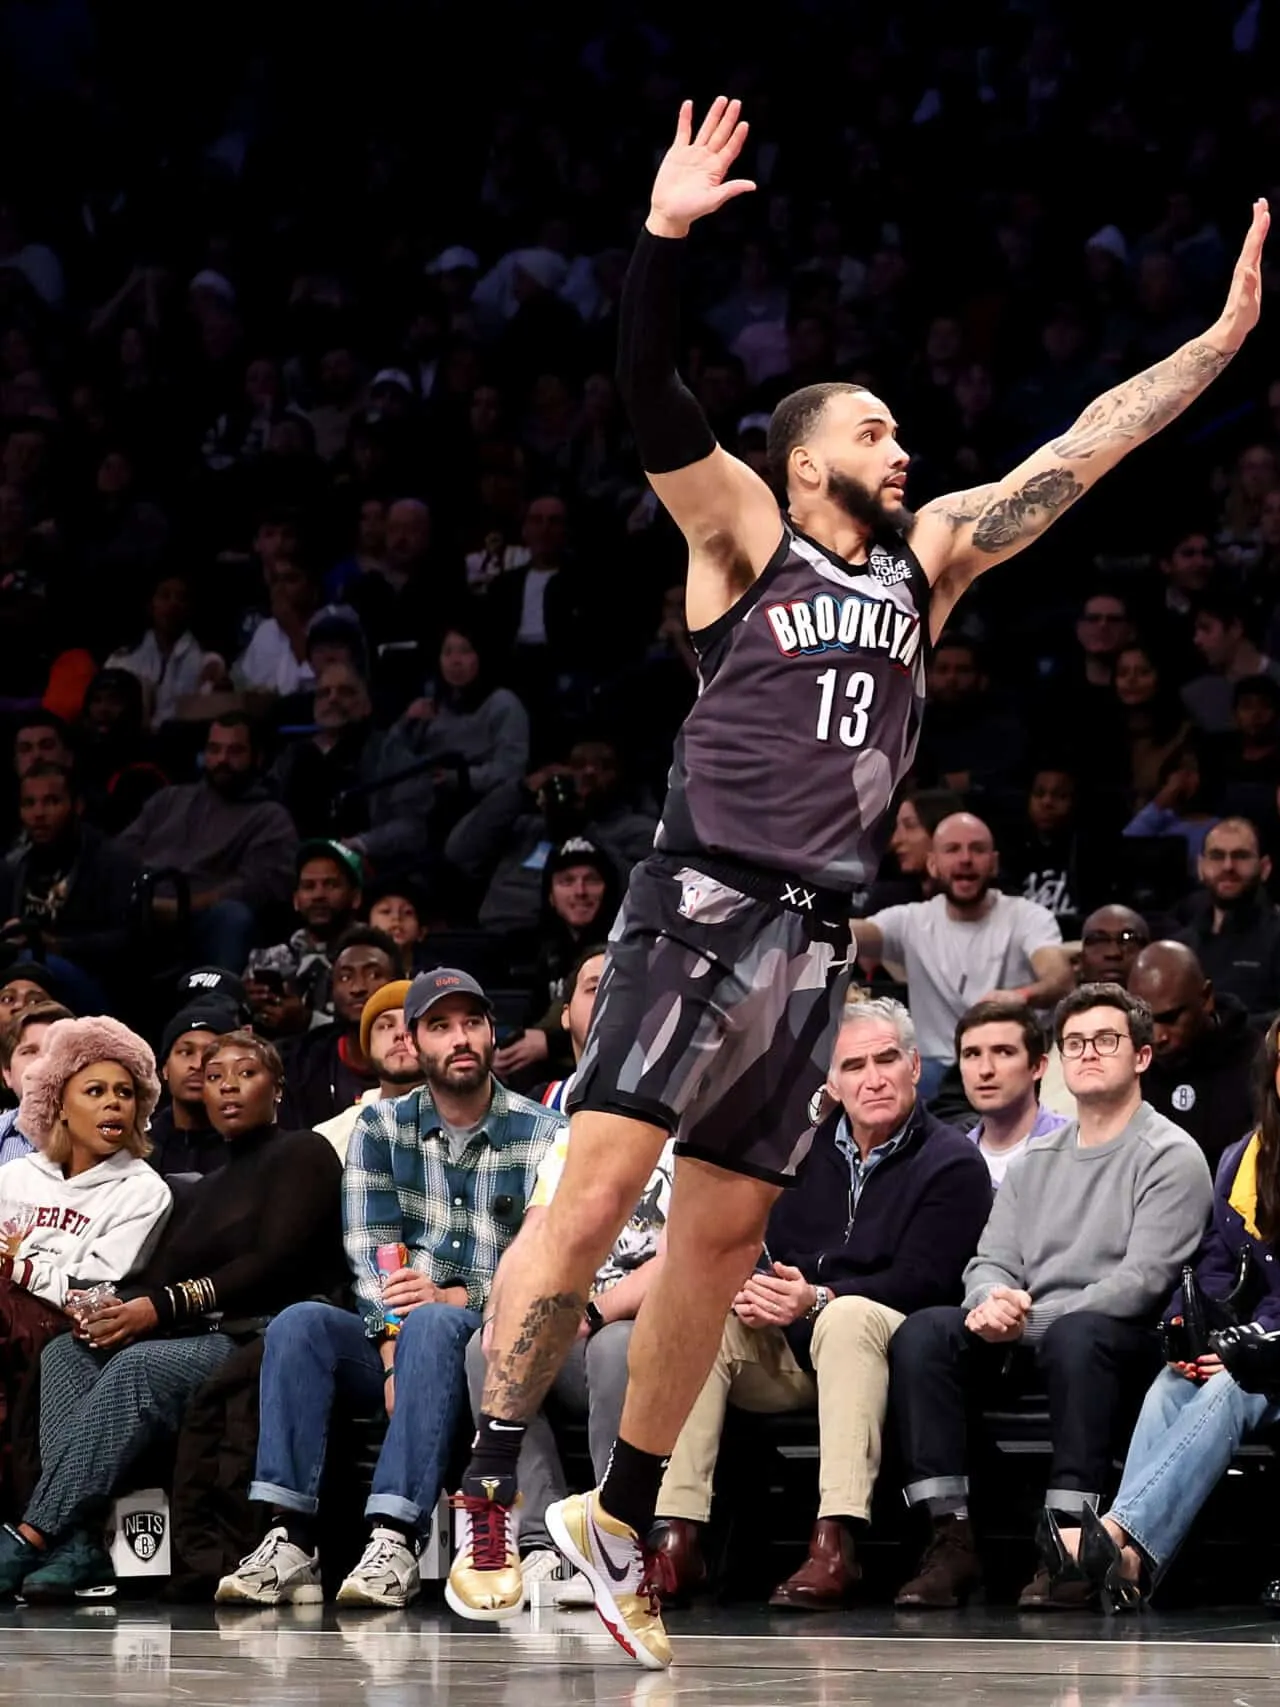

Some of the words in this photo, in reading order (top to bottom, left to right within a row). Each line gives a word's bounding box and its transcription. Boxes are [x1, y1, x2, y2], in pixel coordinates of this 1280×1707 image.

[870, 555, 895, 567] GET
[872, 559, 907, 576] YOUR
[815, 668, 875, 747] 13
[125, 1513, 164, 1537] NETS
